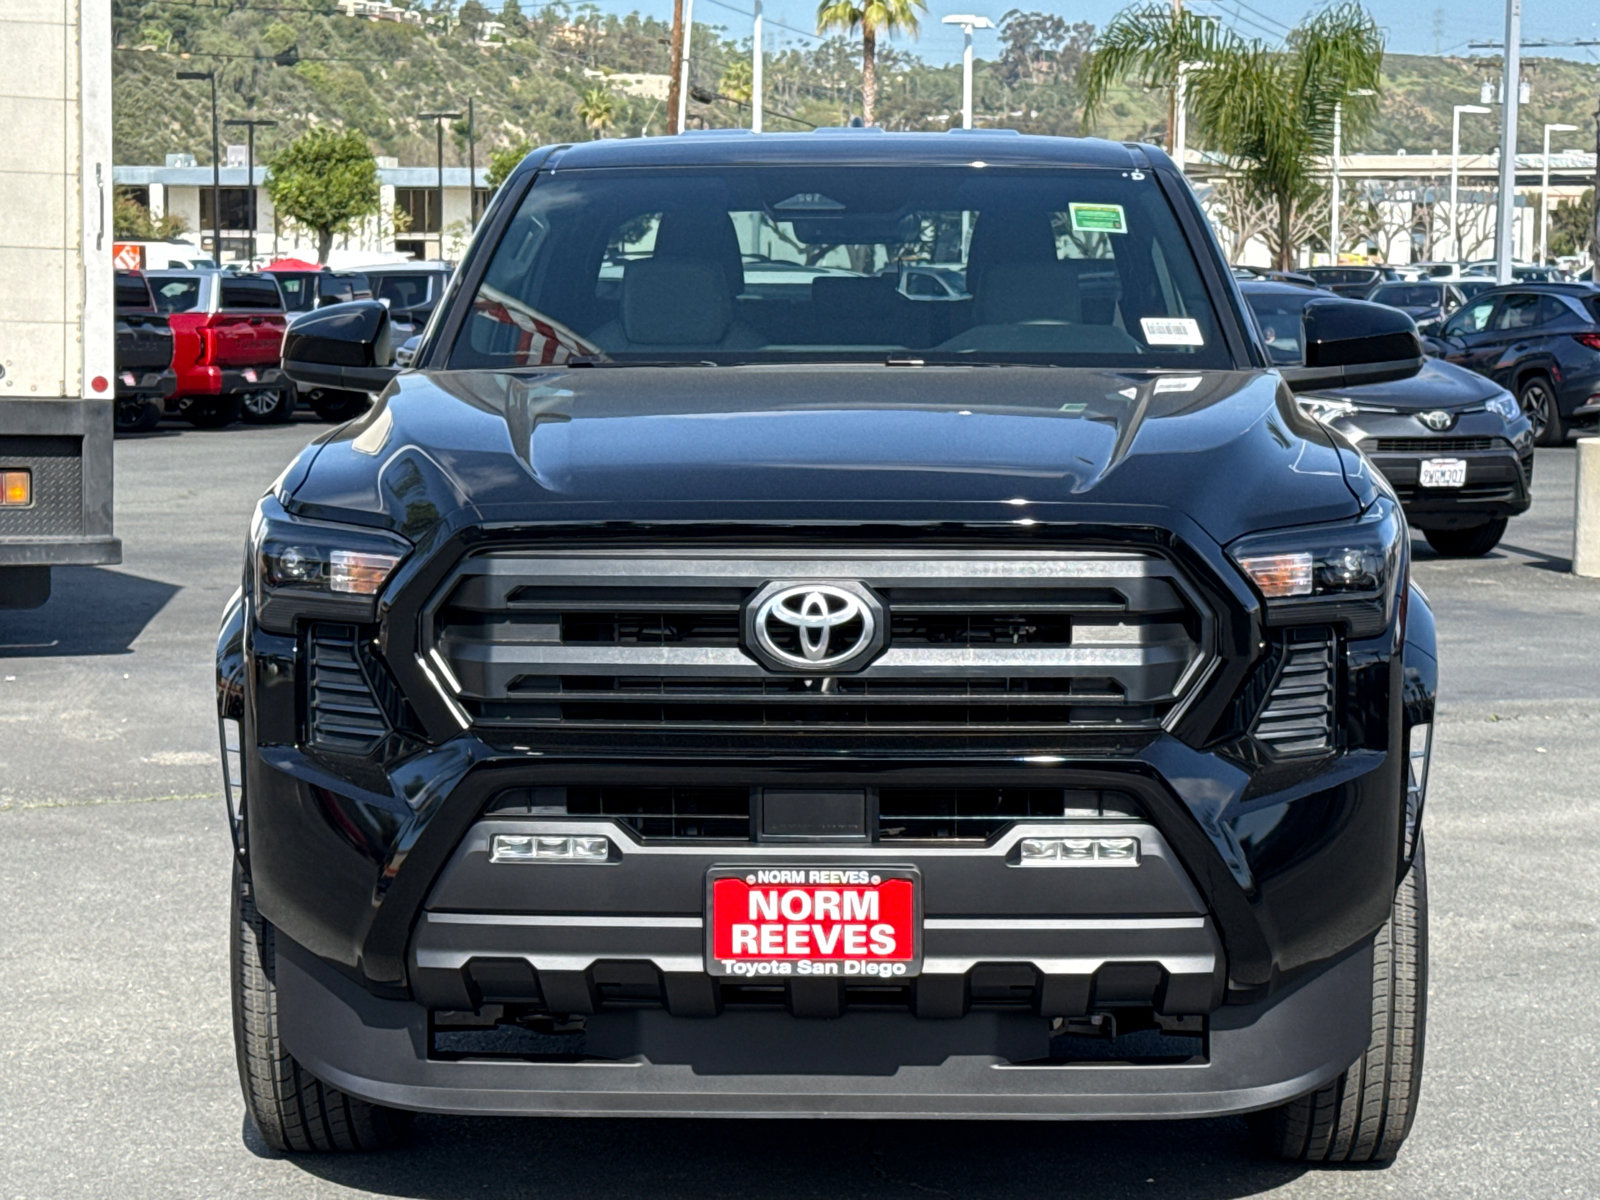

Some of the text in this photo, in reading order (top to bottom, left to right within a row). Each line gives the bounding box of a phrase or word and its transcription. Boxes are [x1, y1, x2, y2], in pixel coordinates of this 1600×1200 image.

[757, 870, 869, 884] NORM REEVES
[748, 890, 880, 921] NORM
[731, 923, 897, 955] REEVES
[721, 960, 907, 977] Toyota San Diego
